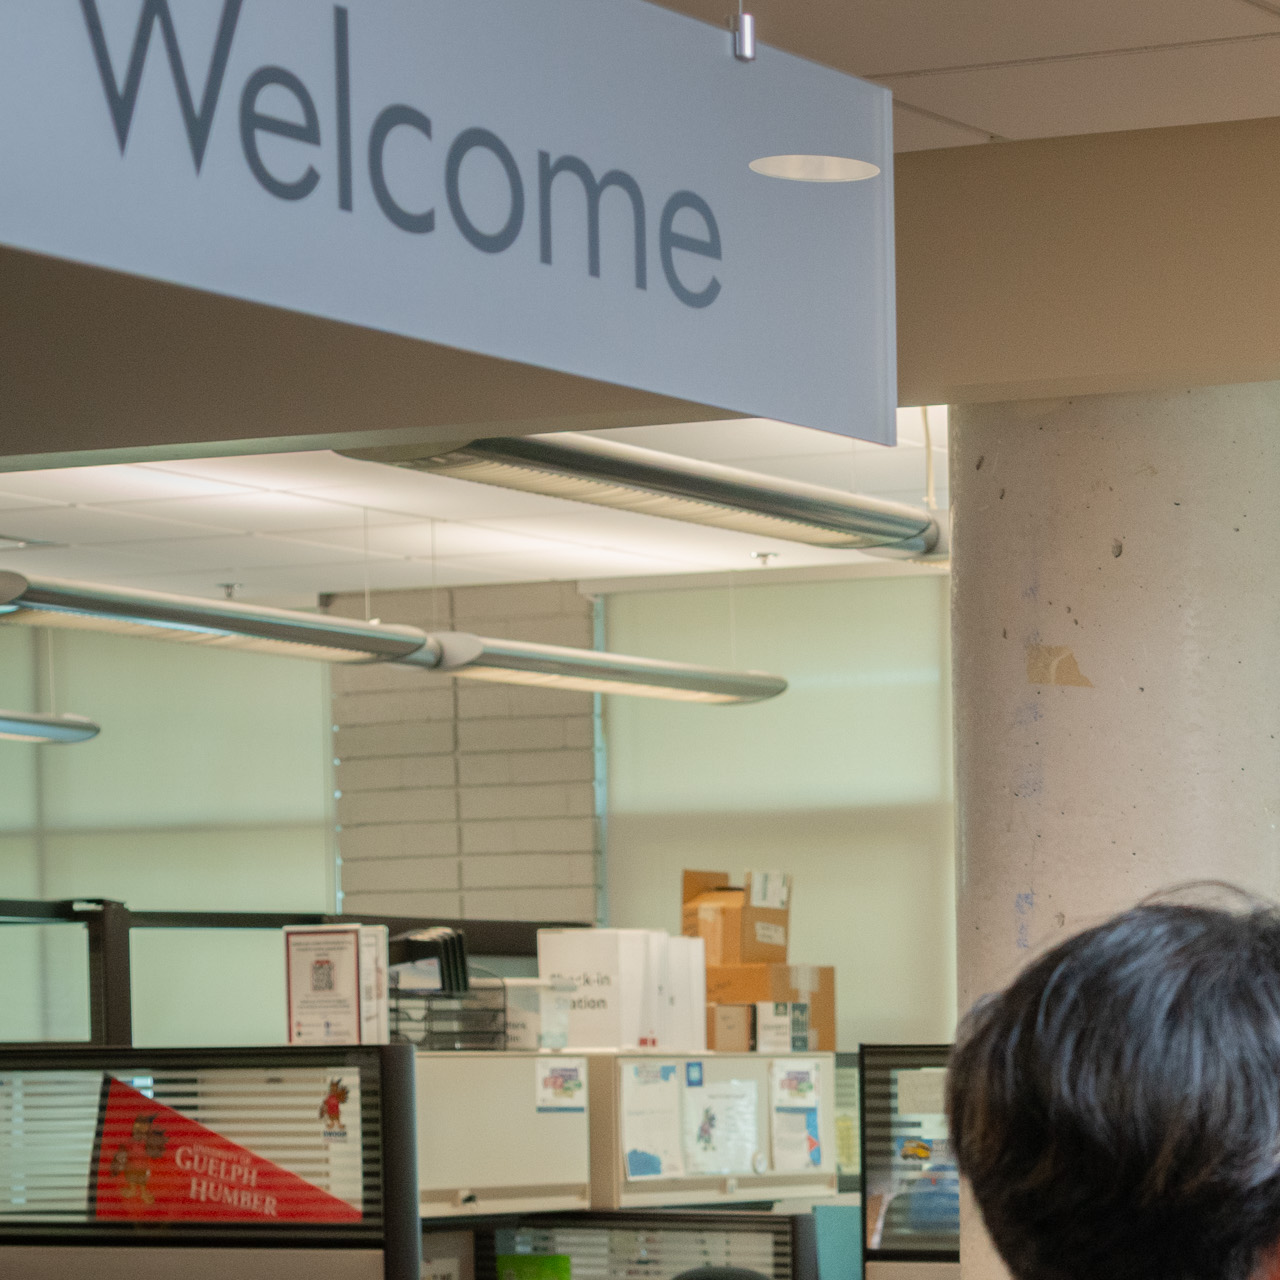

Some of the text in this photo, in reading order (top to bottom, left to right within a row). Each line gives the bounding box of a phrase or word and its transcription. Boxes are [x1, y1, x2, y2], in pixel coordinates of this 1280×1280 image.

[78, 0, 724, 310] Welcome
[175, 1145, 259, 1187] GUELPH
[189, 1177, 278, 1217] HUMBER
